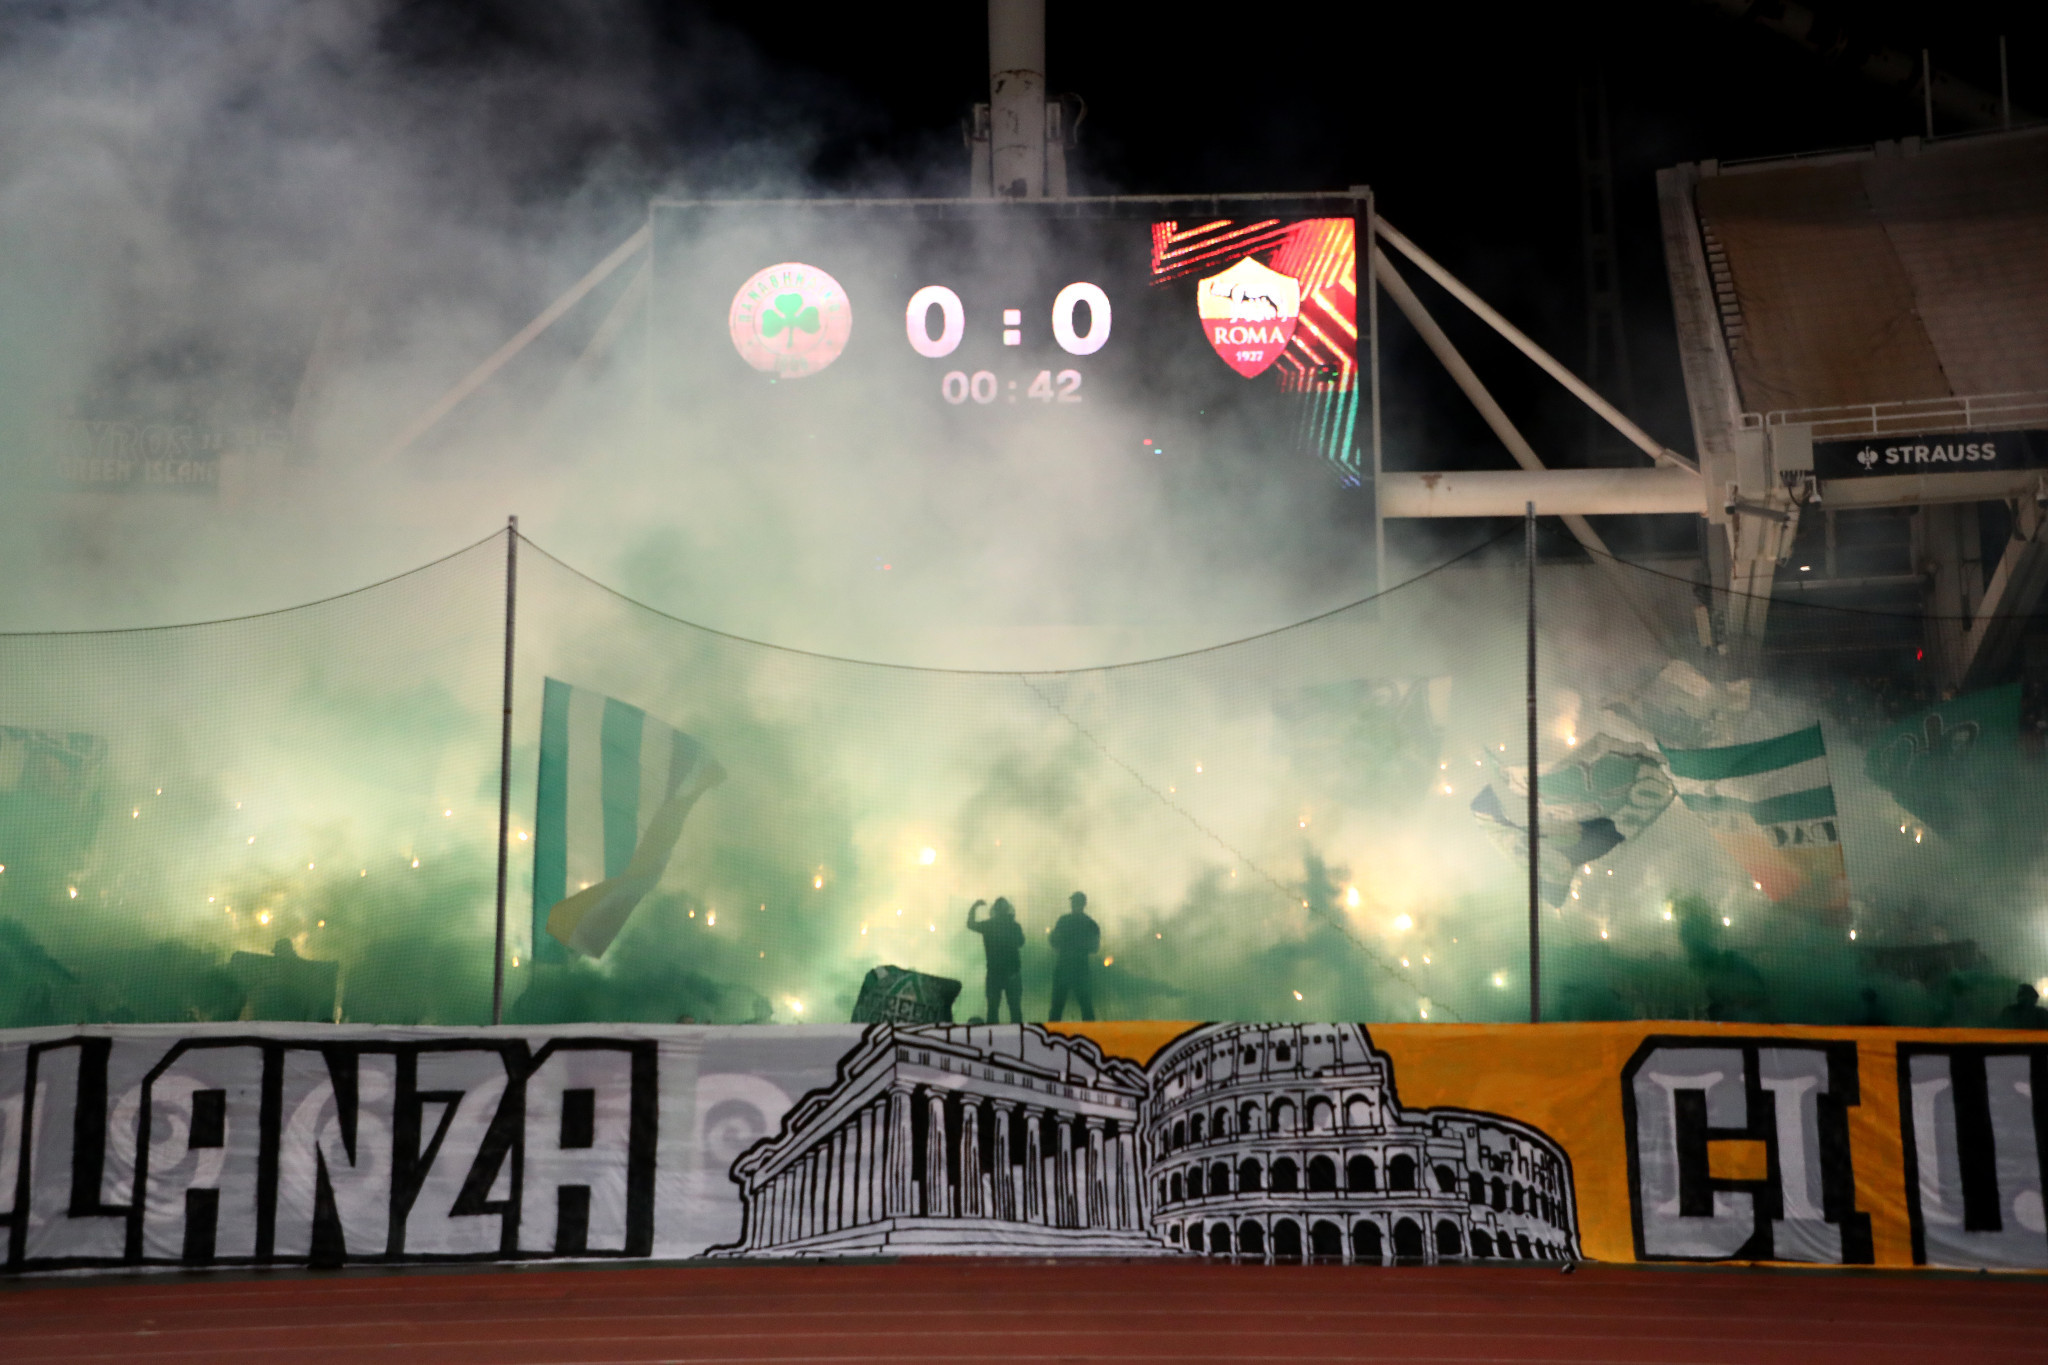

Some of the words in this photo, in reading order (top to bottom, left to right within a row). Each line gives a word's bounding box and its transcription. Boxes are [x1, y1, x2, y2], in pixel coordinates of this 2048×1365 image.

[906, 285, 965, 358] 0
[1052, 281, 1112, 355] 0
[1214, 326, 1285, 345] ROMA
[1235, 351, 1264, 362] 1927
[1885, 443, 1996, 465] STRAUSS
[0, 1036, 658, 1271] LANZA
